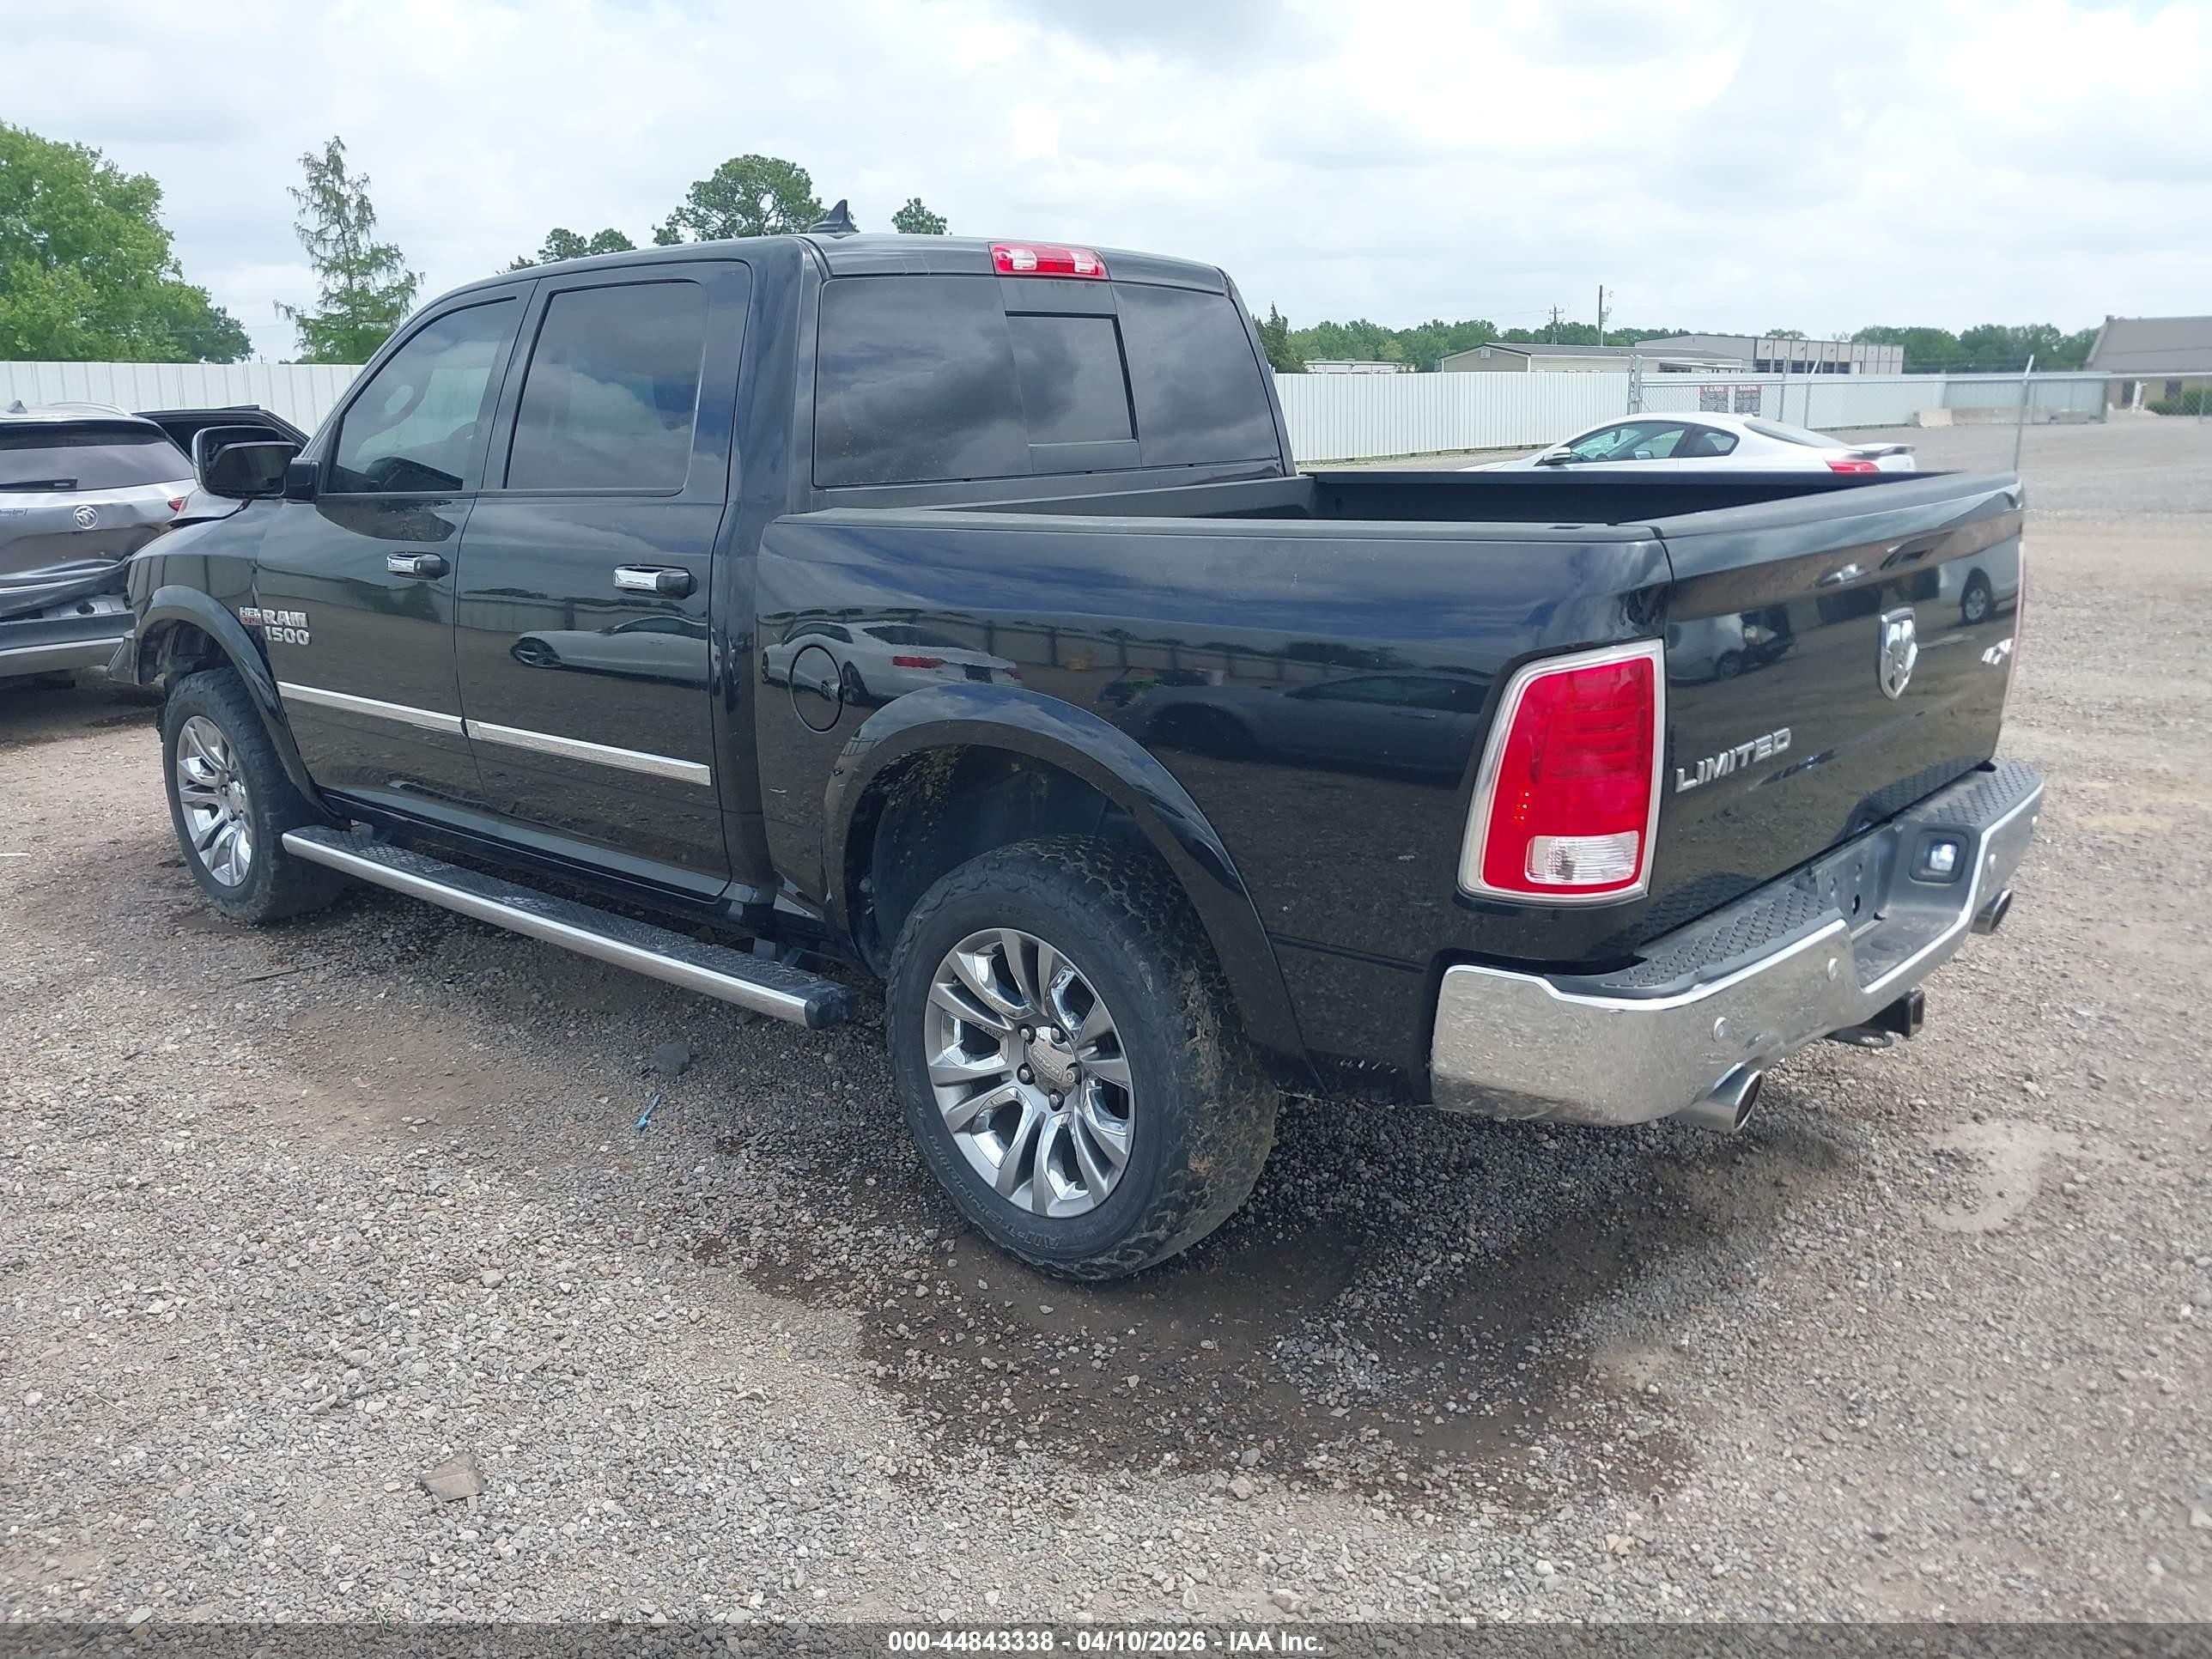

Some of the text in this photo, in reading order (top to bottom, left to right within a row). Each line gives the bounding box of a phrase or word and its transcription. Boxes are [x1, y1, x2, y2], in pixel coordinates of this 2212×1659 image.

[262, 608, 308, 628] RAM
[264, 626, 310, 646] 1500
[1675, 726, 1791, 793] LIMITED
